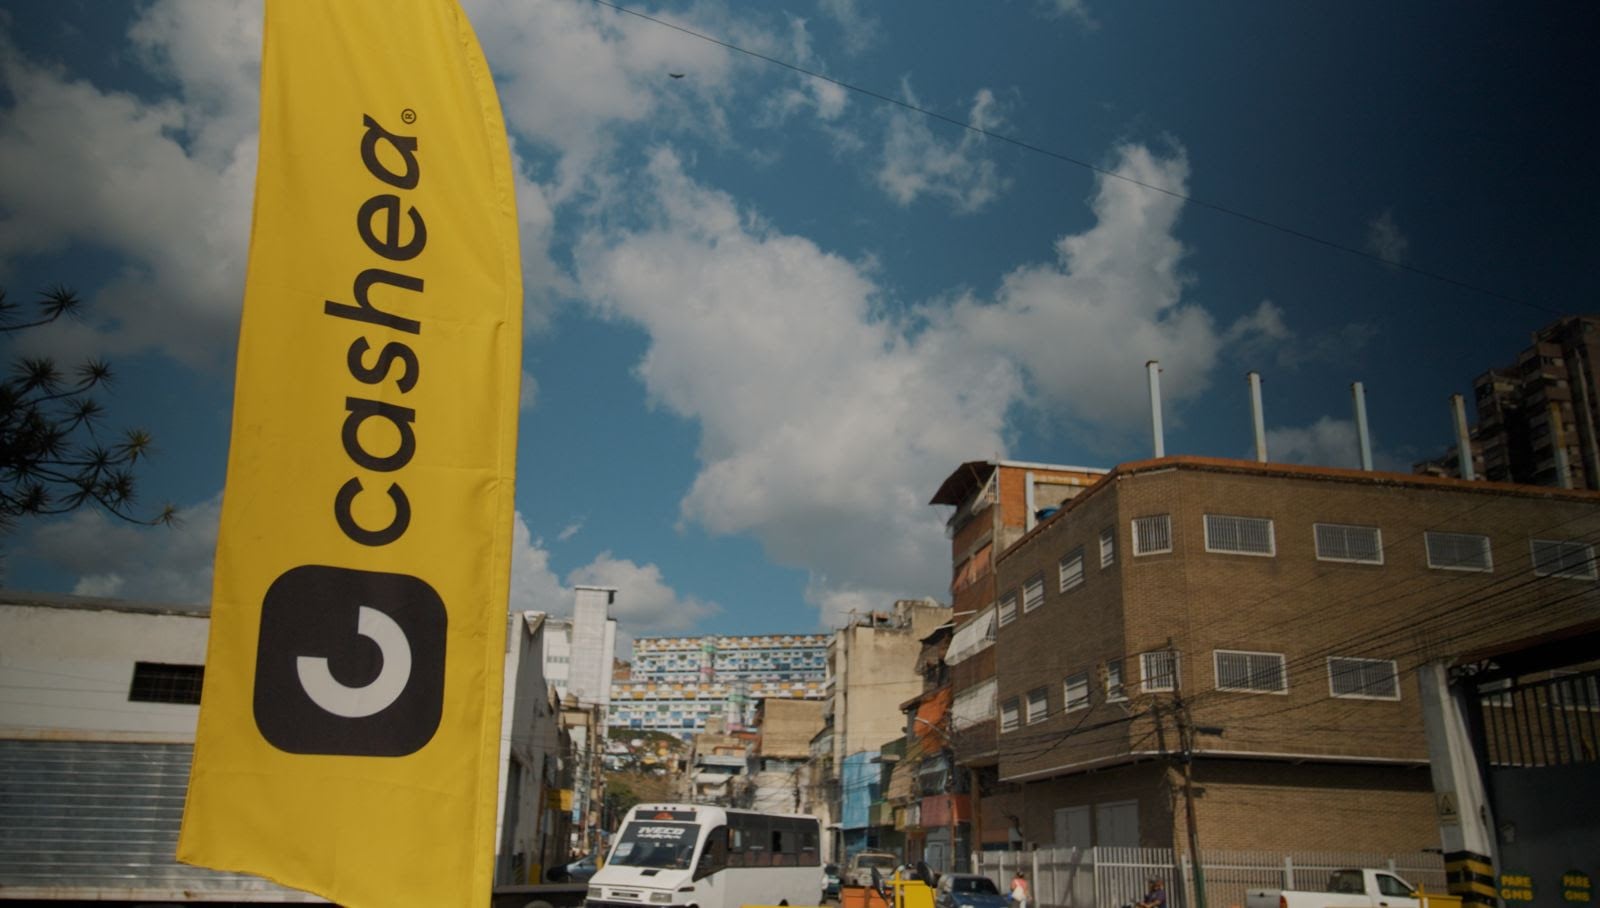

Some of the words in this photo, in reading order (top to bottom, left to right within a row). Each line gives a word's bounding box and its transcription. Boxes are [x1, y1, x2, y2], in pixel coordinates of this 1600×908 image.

[638, 826, 685, 835] IVECO
[1501, 875, 1532, 888] PARE
[1563, 876, 1591, 889] PARE
